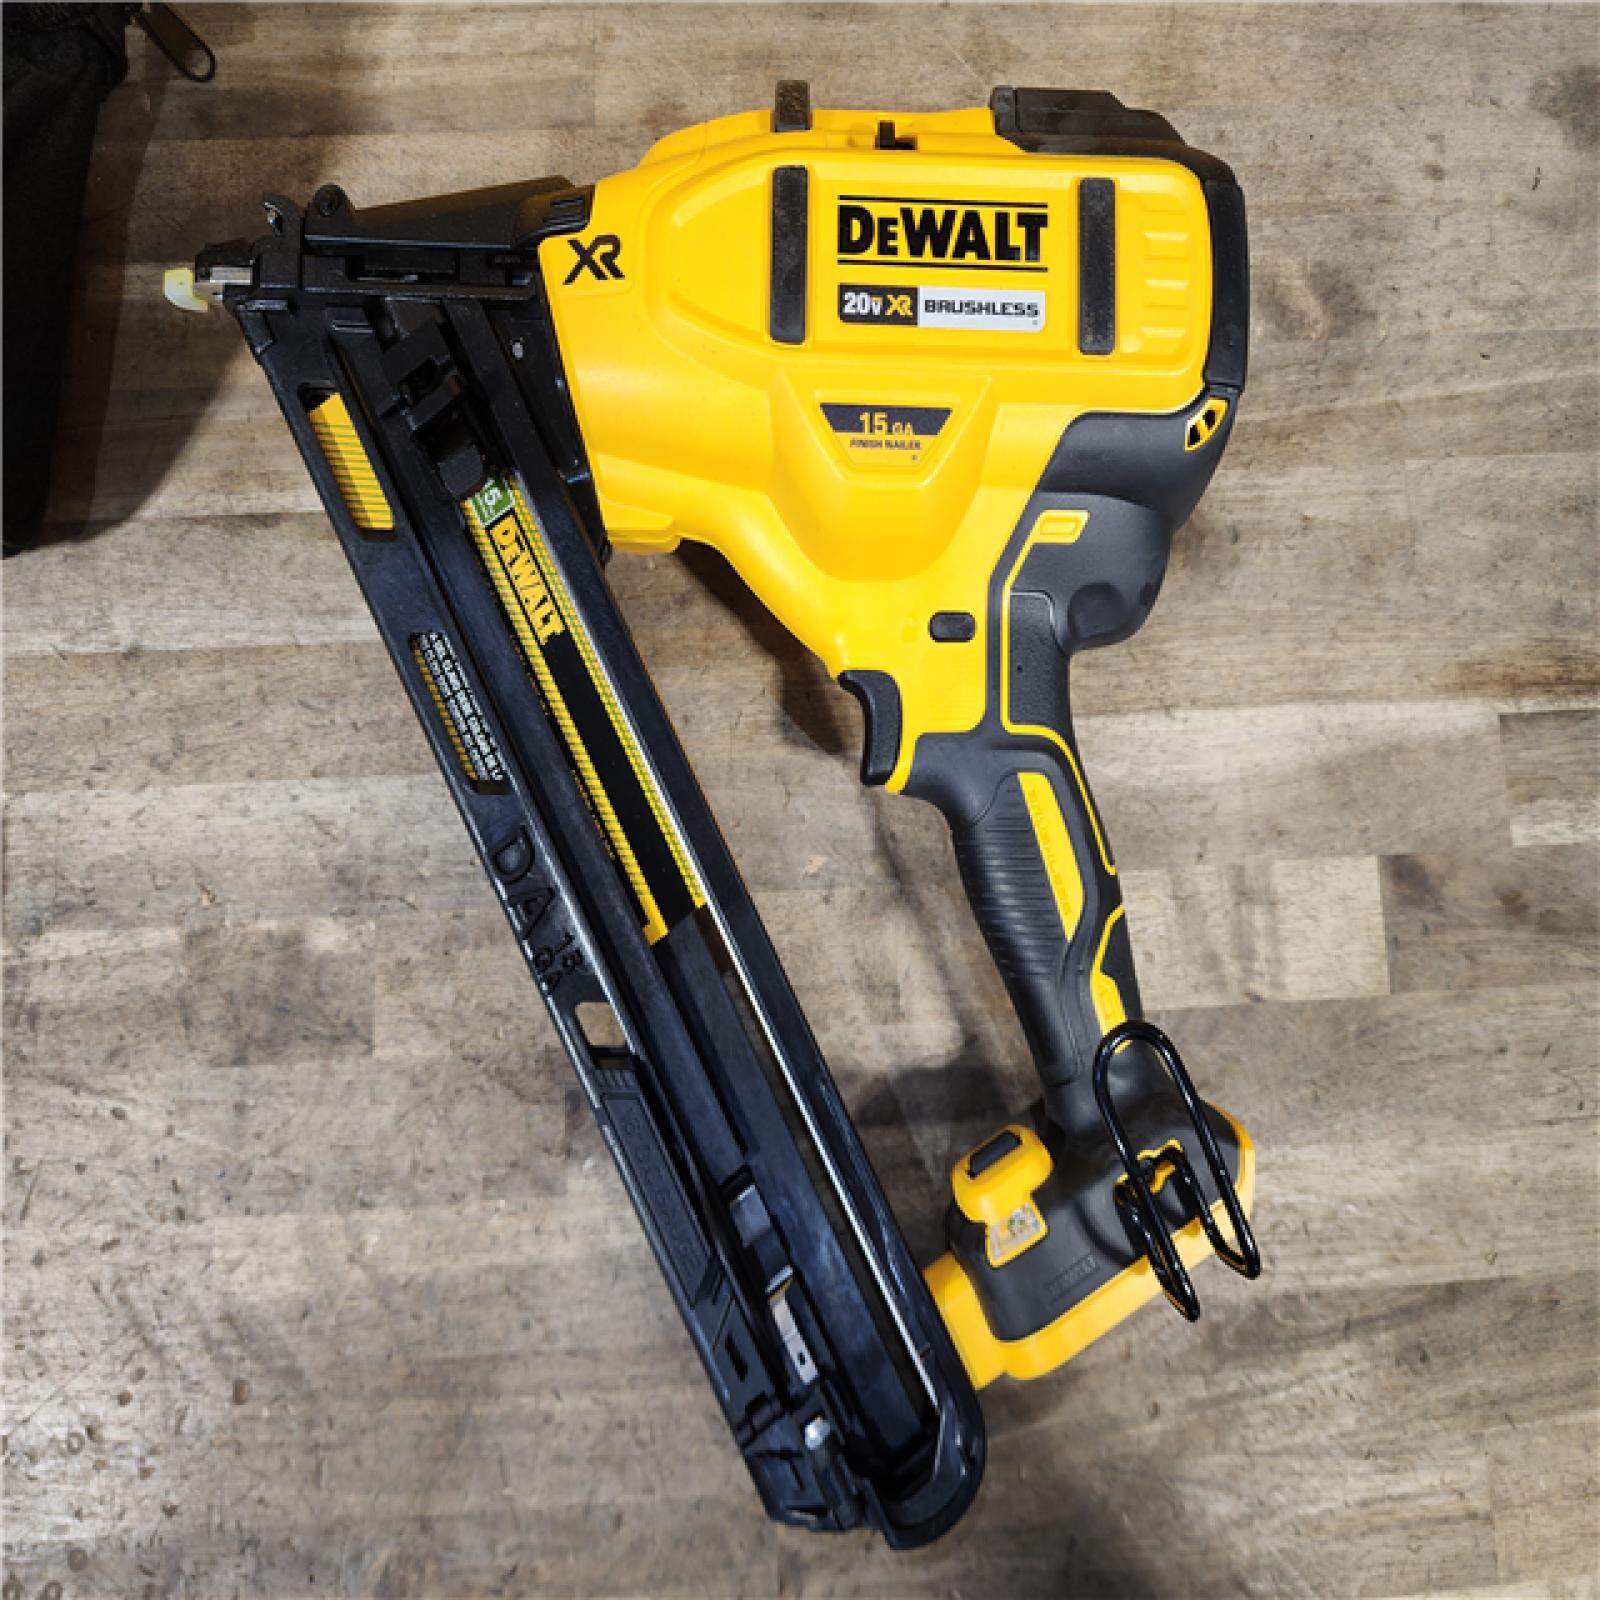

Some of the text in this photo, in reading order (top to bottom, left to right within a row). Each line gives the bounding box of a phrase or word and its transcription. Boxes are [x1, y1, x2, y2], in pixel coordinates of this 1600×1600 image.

[563, 234, 625, 286] XR
[885, 294, 913, 317] XR
[924, 299, 1039, 317] BRUSHLESS
[859, 411, 888, 435] 15
[494, 824, 557, 941] DA
